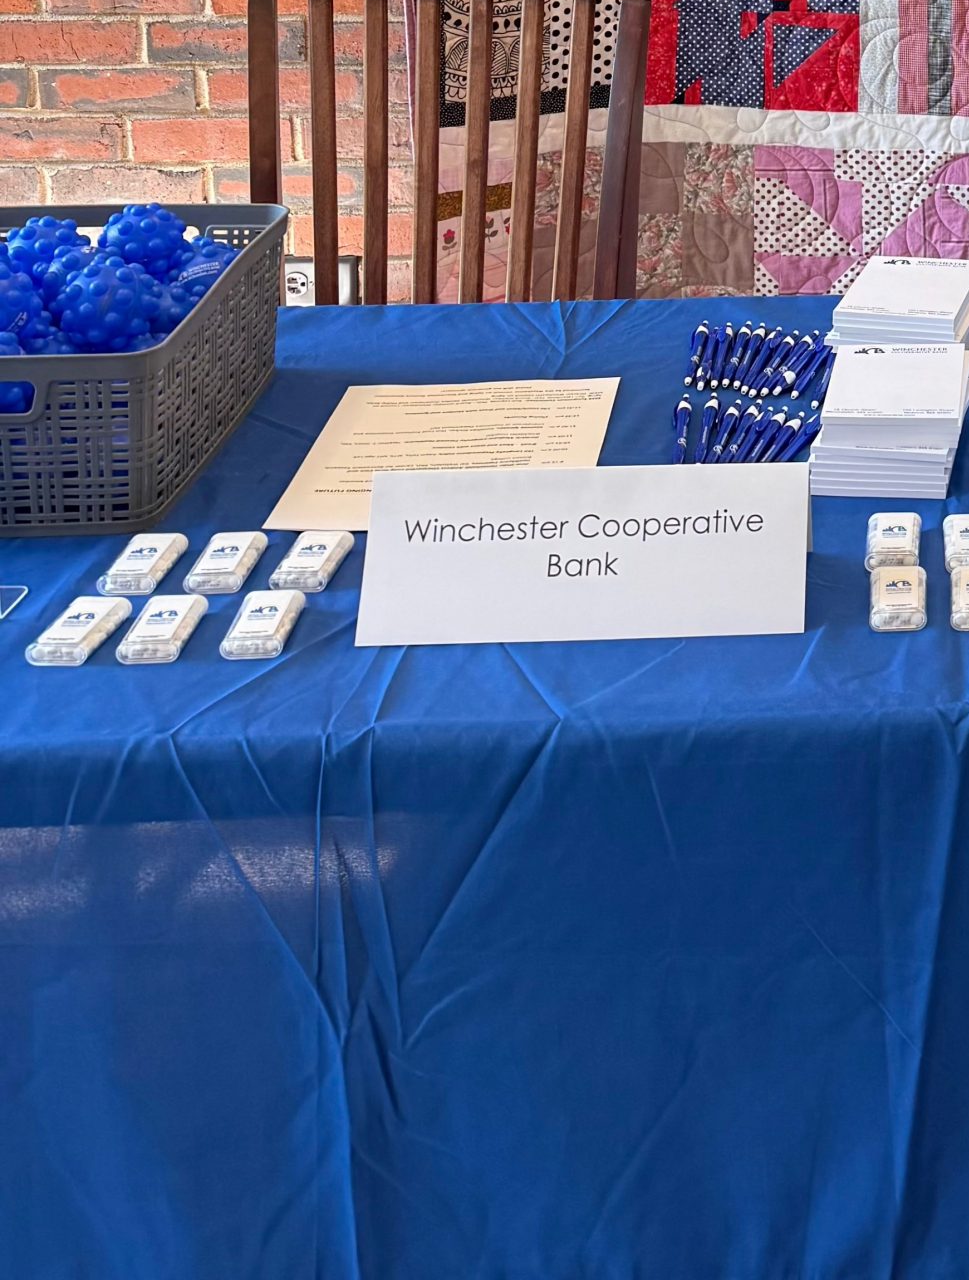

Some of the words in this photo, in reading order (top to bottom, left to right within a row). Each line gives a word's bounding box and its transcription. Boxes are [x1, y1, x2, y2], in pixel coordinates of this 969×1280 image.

[403, 516, 570, 543] Winchester
[577, 508, 765, 542] Cooperative
[546, 551, 620, 578] Bank
